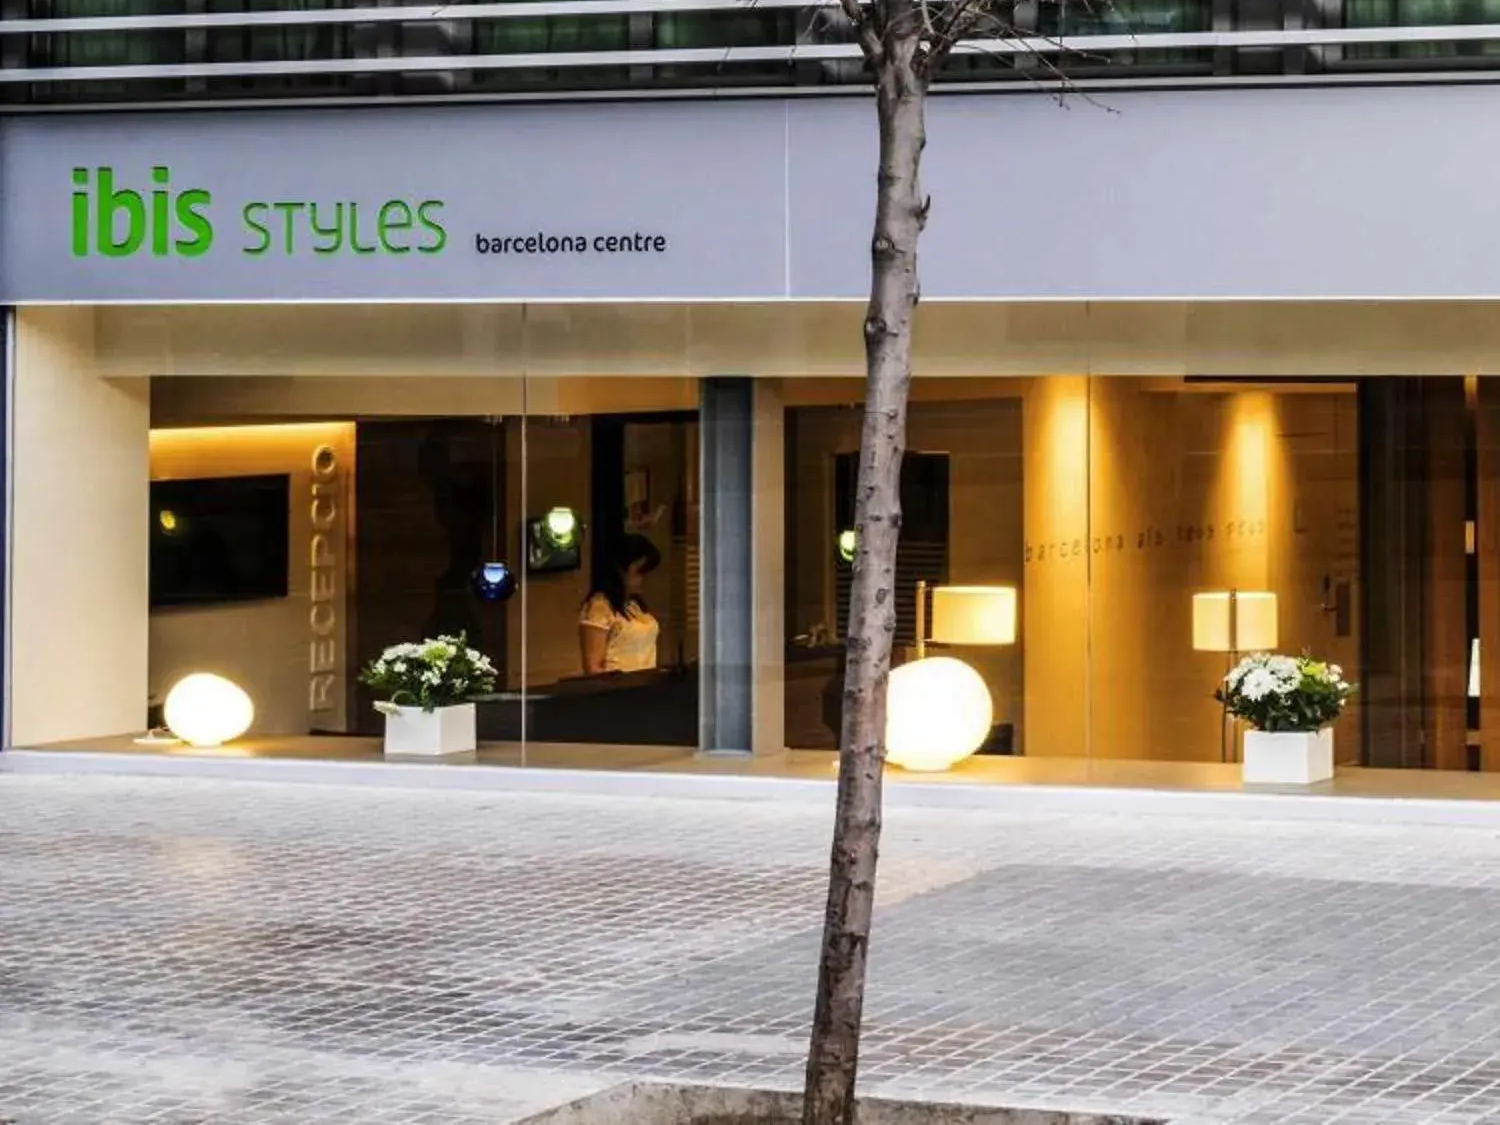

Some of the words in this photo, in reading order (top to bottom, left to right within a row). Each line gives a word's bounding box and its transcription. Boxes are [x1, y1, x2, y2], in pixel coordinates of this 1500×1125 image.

[72, 166, 214, 257] ibis
[475, 232, 587, 254] barcelona
[593, 232, 667, 252] centre
